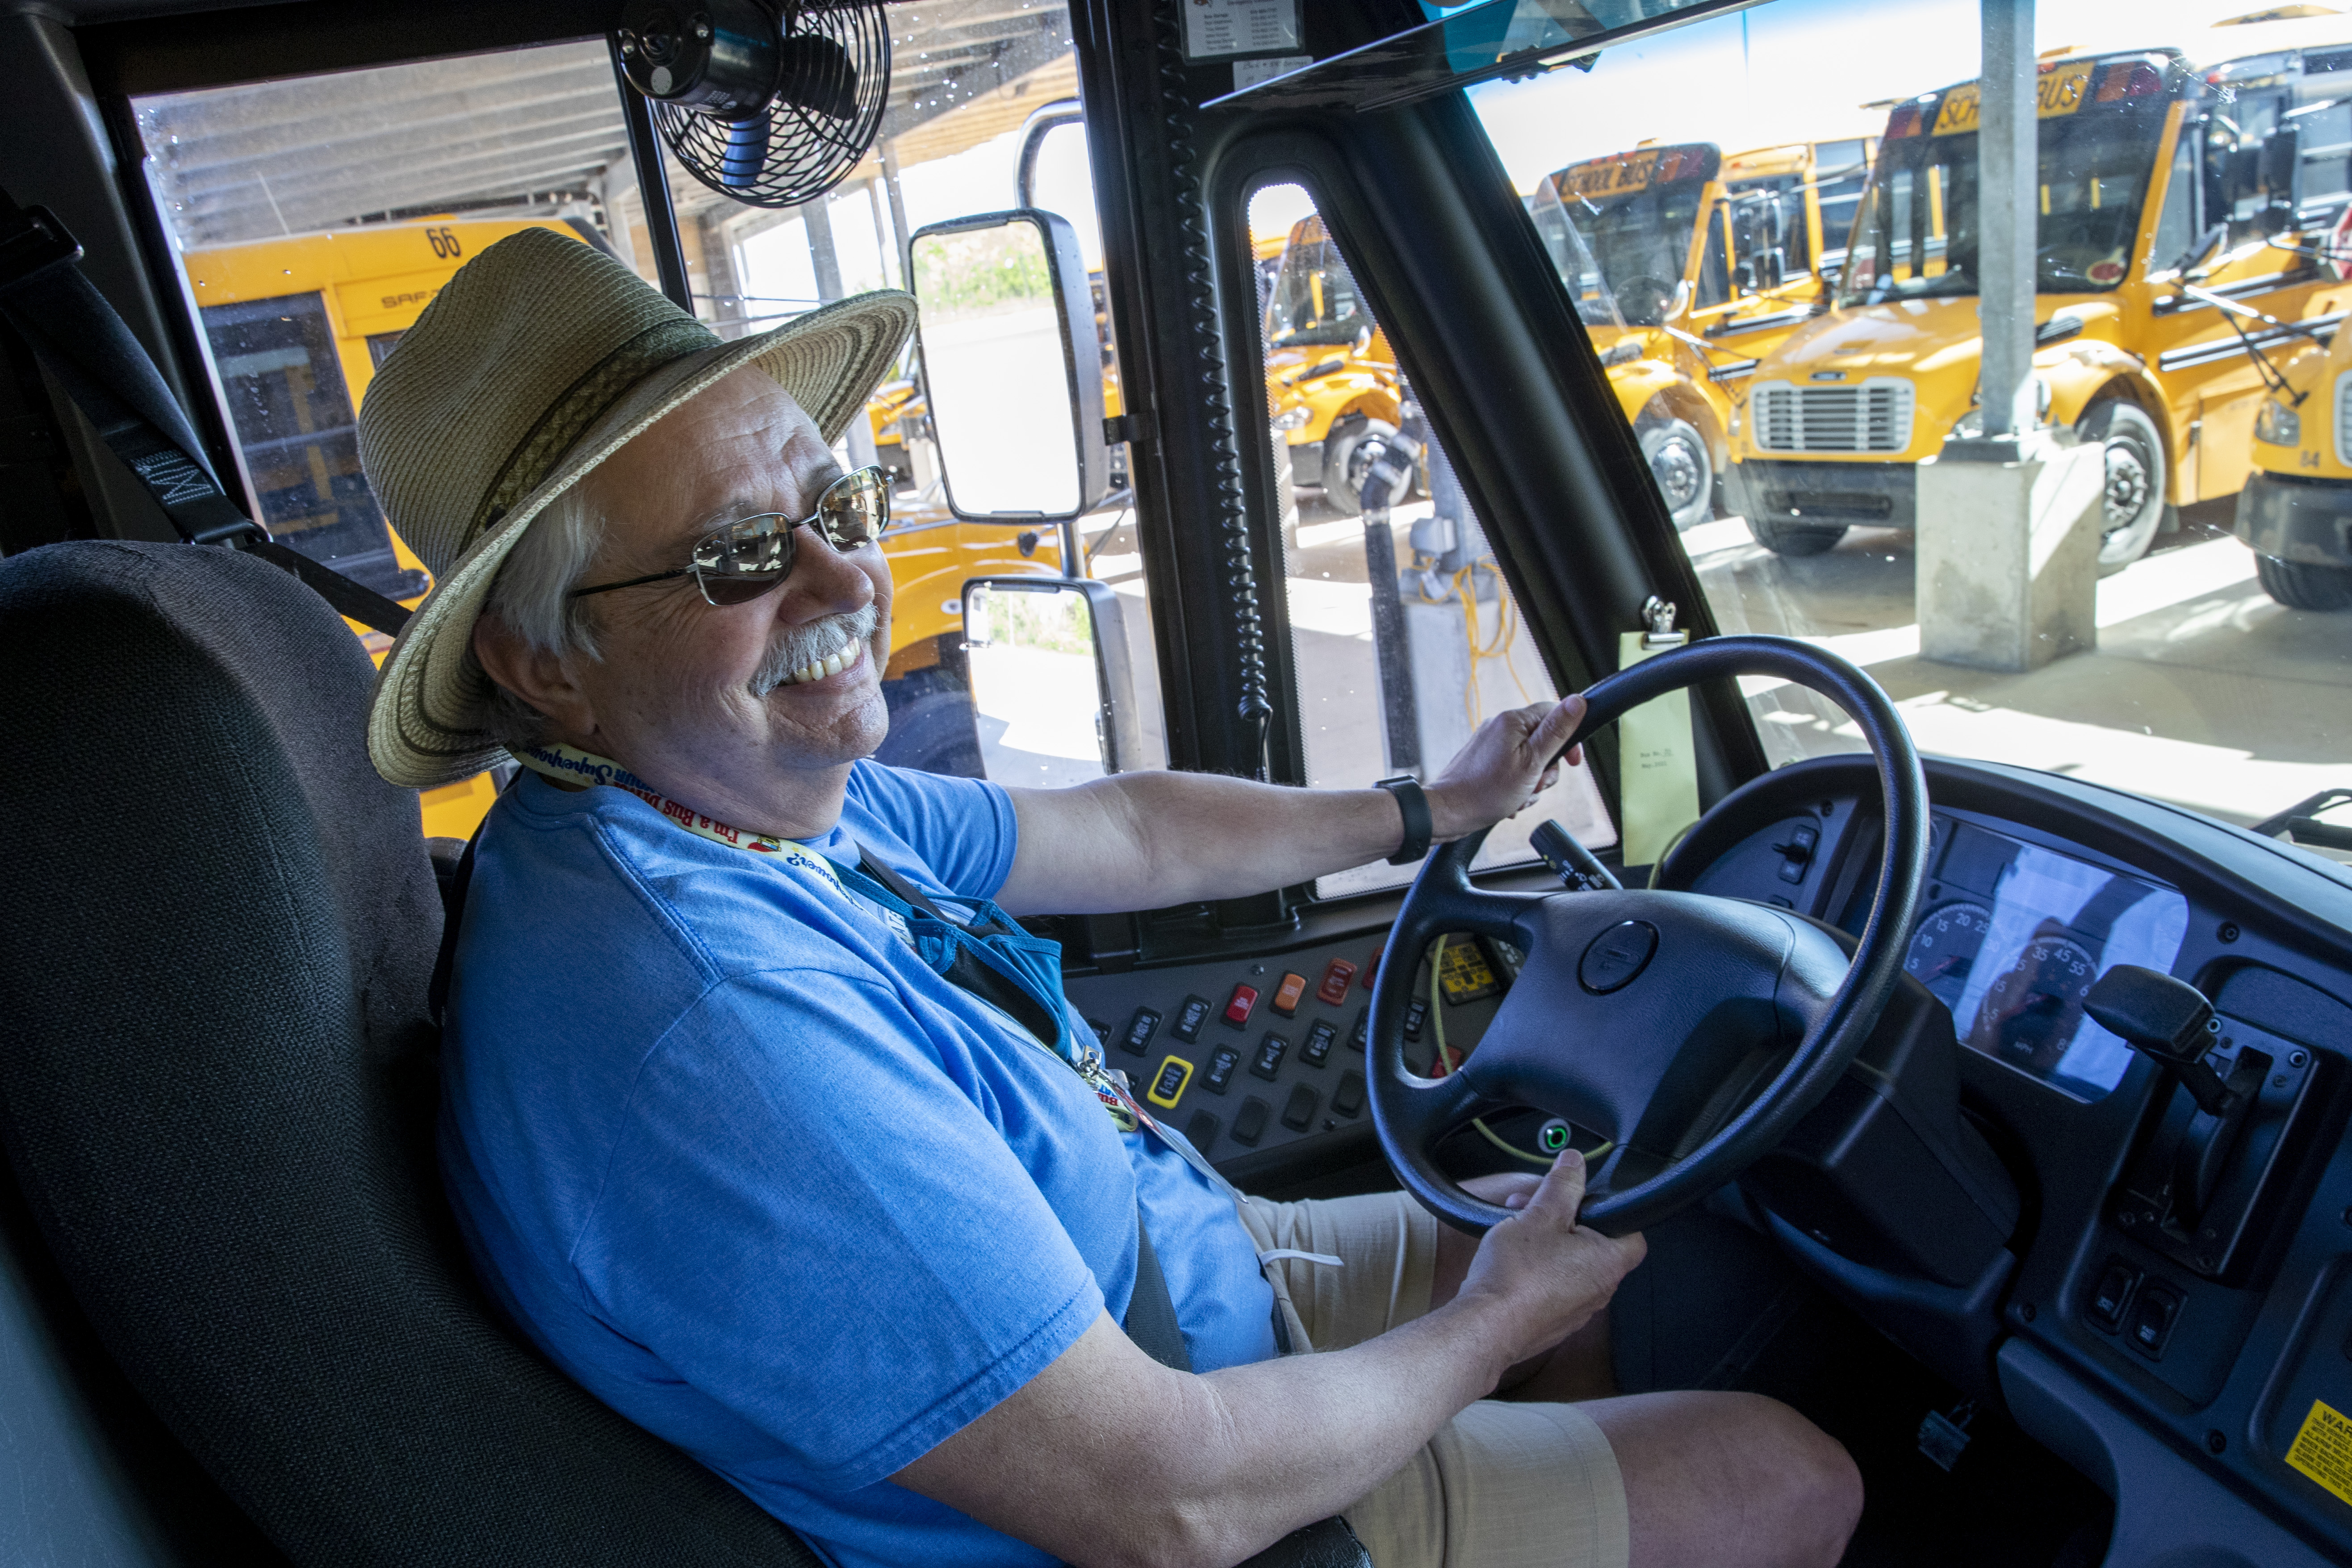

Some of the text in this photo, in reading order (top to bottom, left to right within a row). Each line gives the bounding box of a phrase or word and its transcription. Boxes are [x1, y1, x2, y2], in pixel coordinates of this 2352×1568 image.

[426, 227, 461, 258] 66
[523, 748, 612, 785] Superpow
[1955, 912, 1971, 927] 20
[2032, 946, 2049, 961] 35
[2055, 949, 2072, 962] 45
[2068, 961, 2086, 976] 55
[2080, 984, 2090, 997] 6
